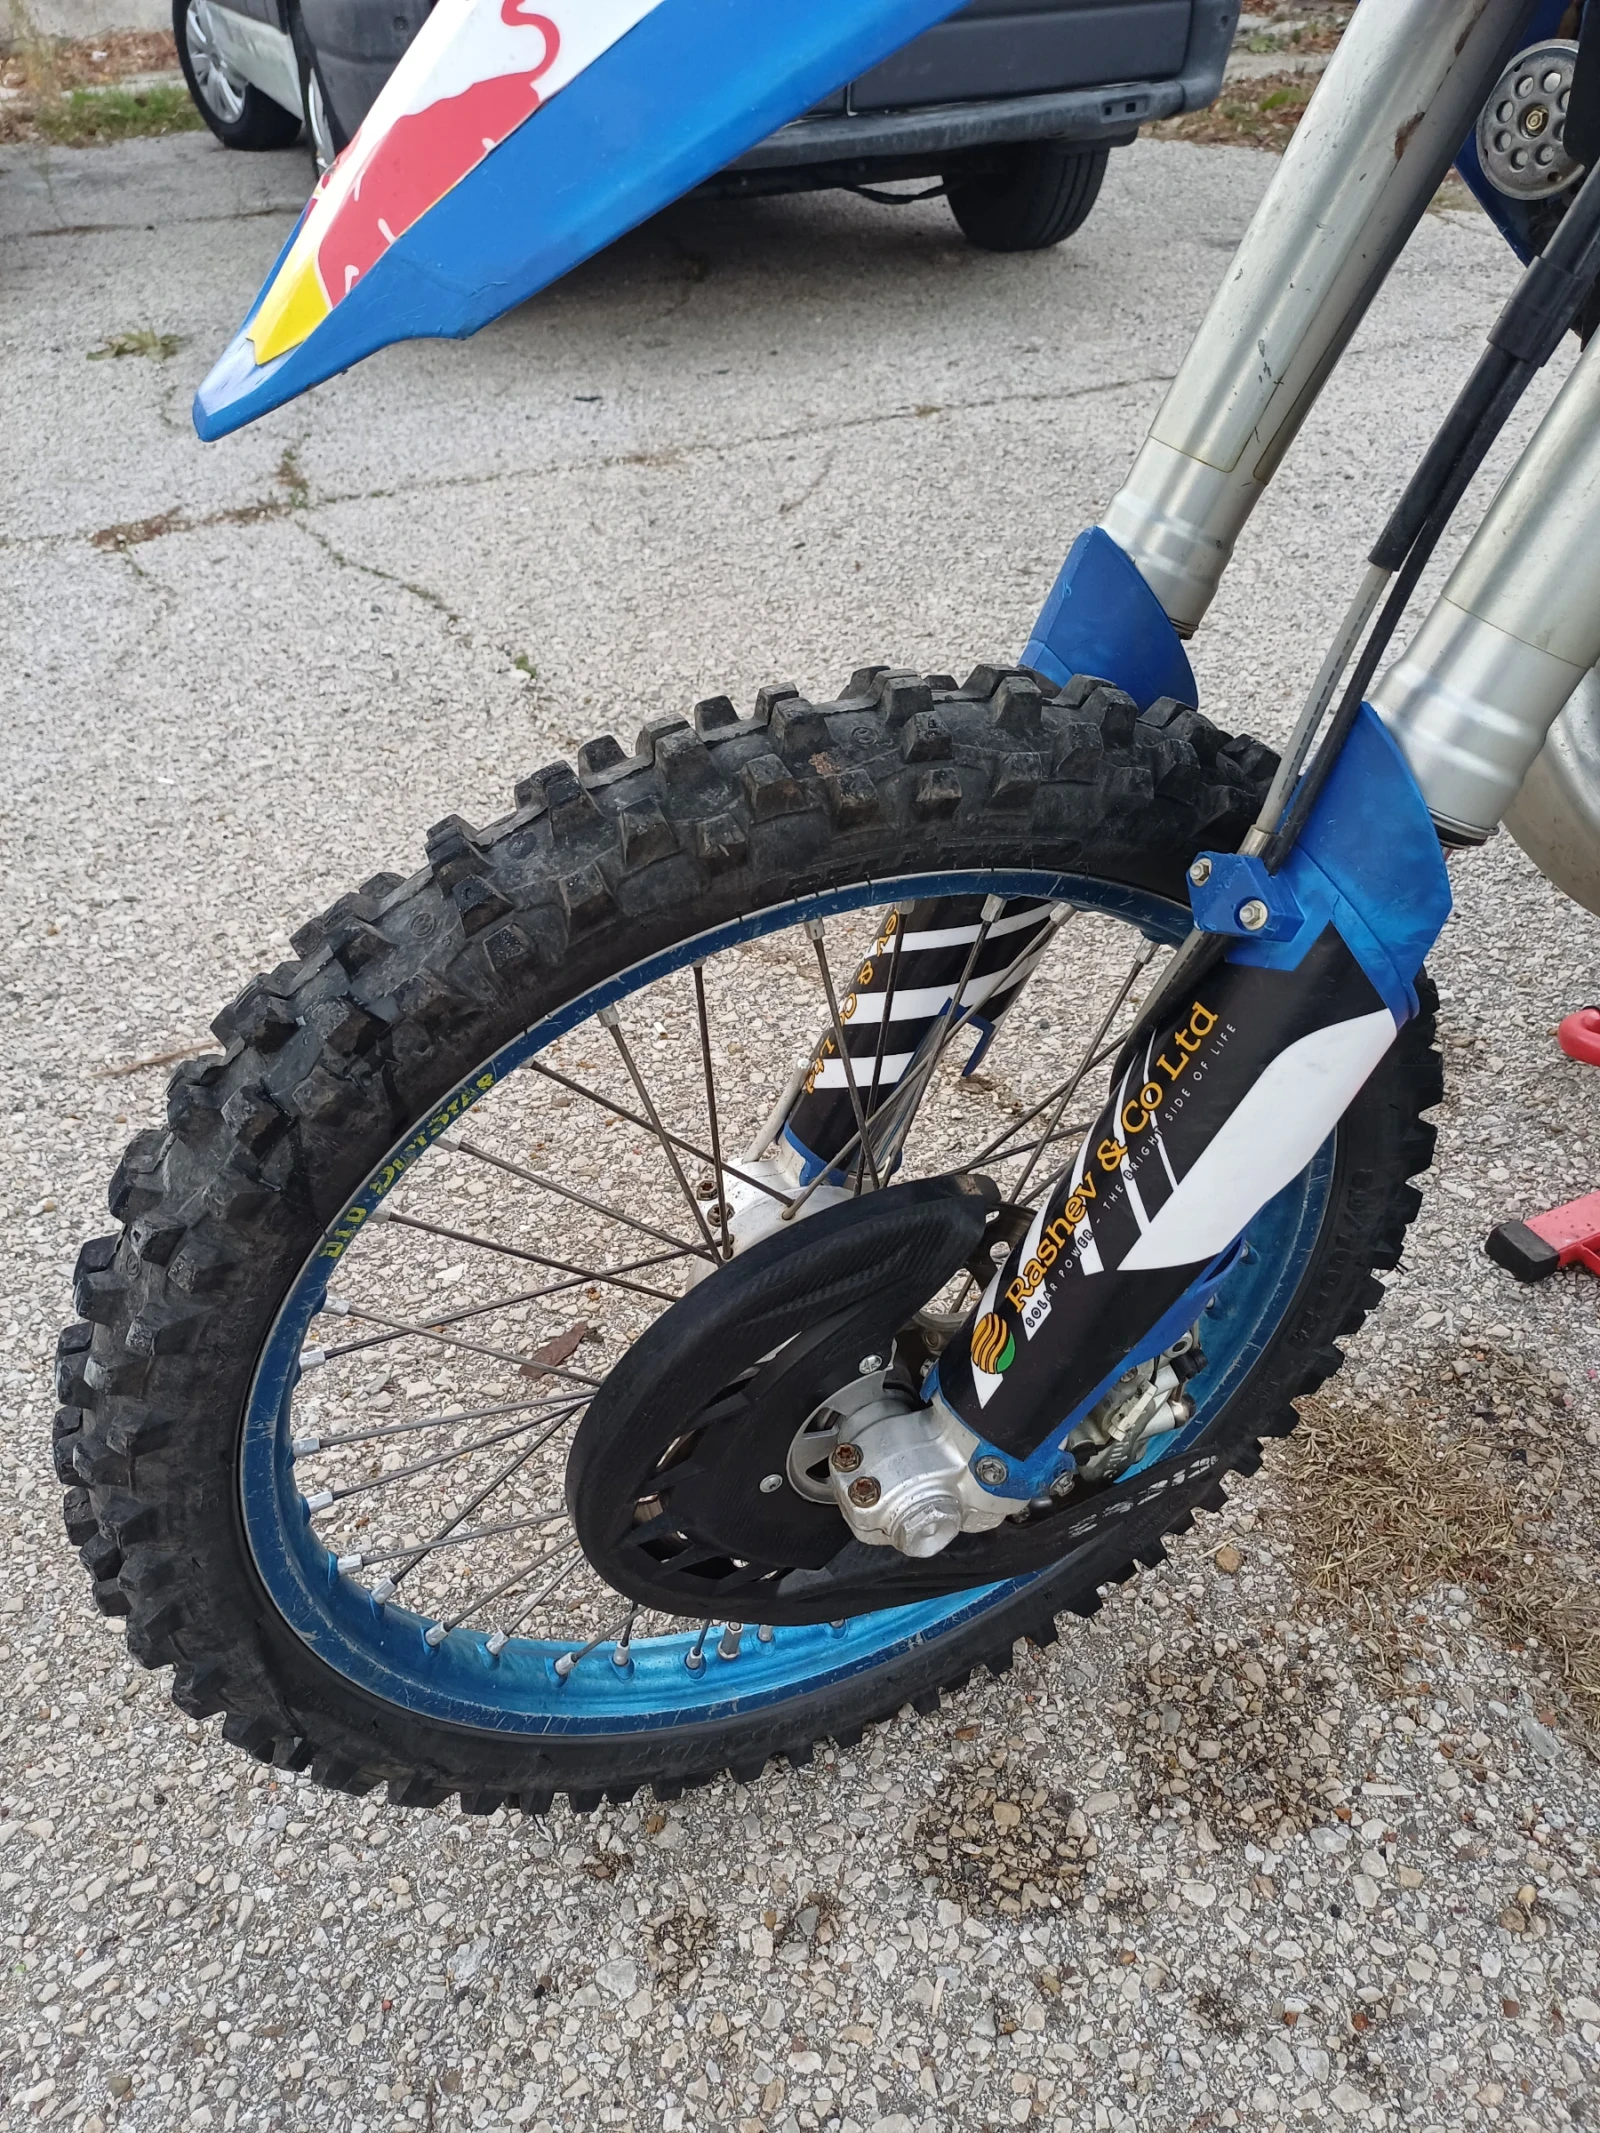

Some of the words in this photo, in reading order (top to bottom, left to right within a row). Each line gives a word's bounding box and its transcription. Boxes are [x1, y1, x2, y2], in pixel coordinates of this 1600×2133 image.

[1005, 1171, 1098, 1314] Rashev
[1096, 1136, 1128, 1172] &
[1120, 1081, 1164, 1134] Co
[1156, 1001, 1219, 1081] Ltd
[1025, 1281, 1058, 1328] SOLAR
[1059, 1229, 1094, 1279] POWER
[1103, 1179, 1125, 1211] THE
[1124, 1127, 1164, 1181] BRIGHT
[1165, 1088, 1191, 1122] SIDE
[1193, 1060, 1209, 1082] OF
[1211, 1022, 1237, 1056] LIFE
